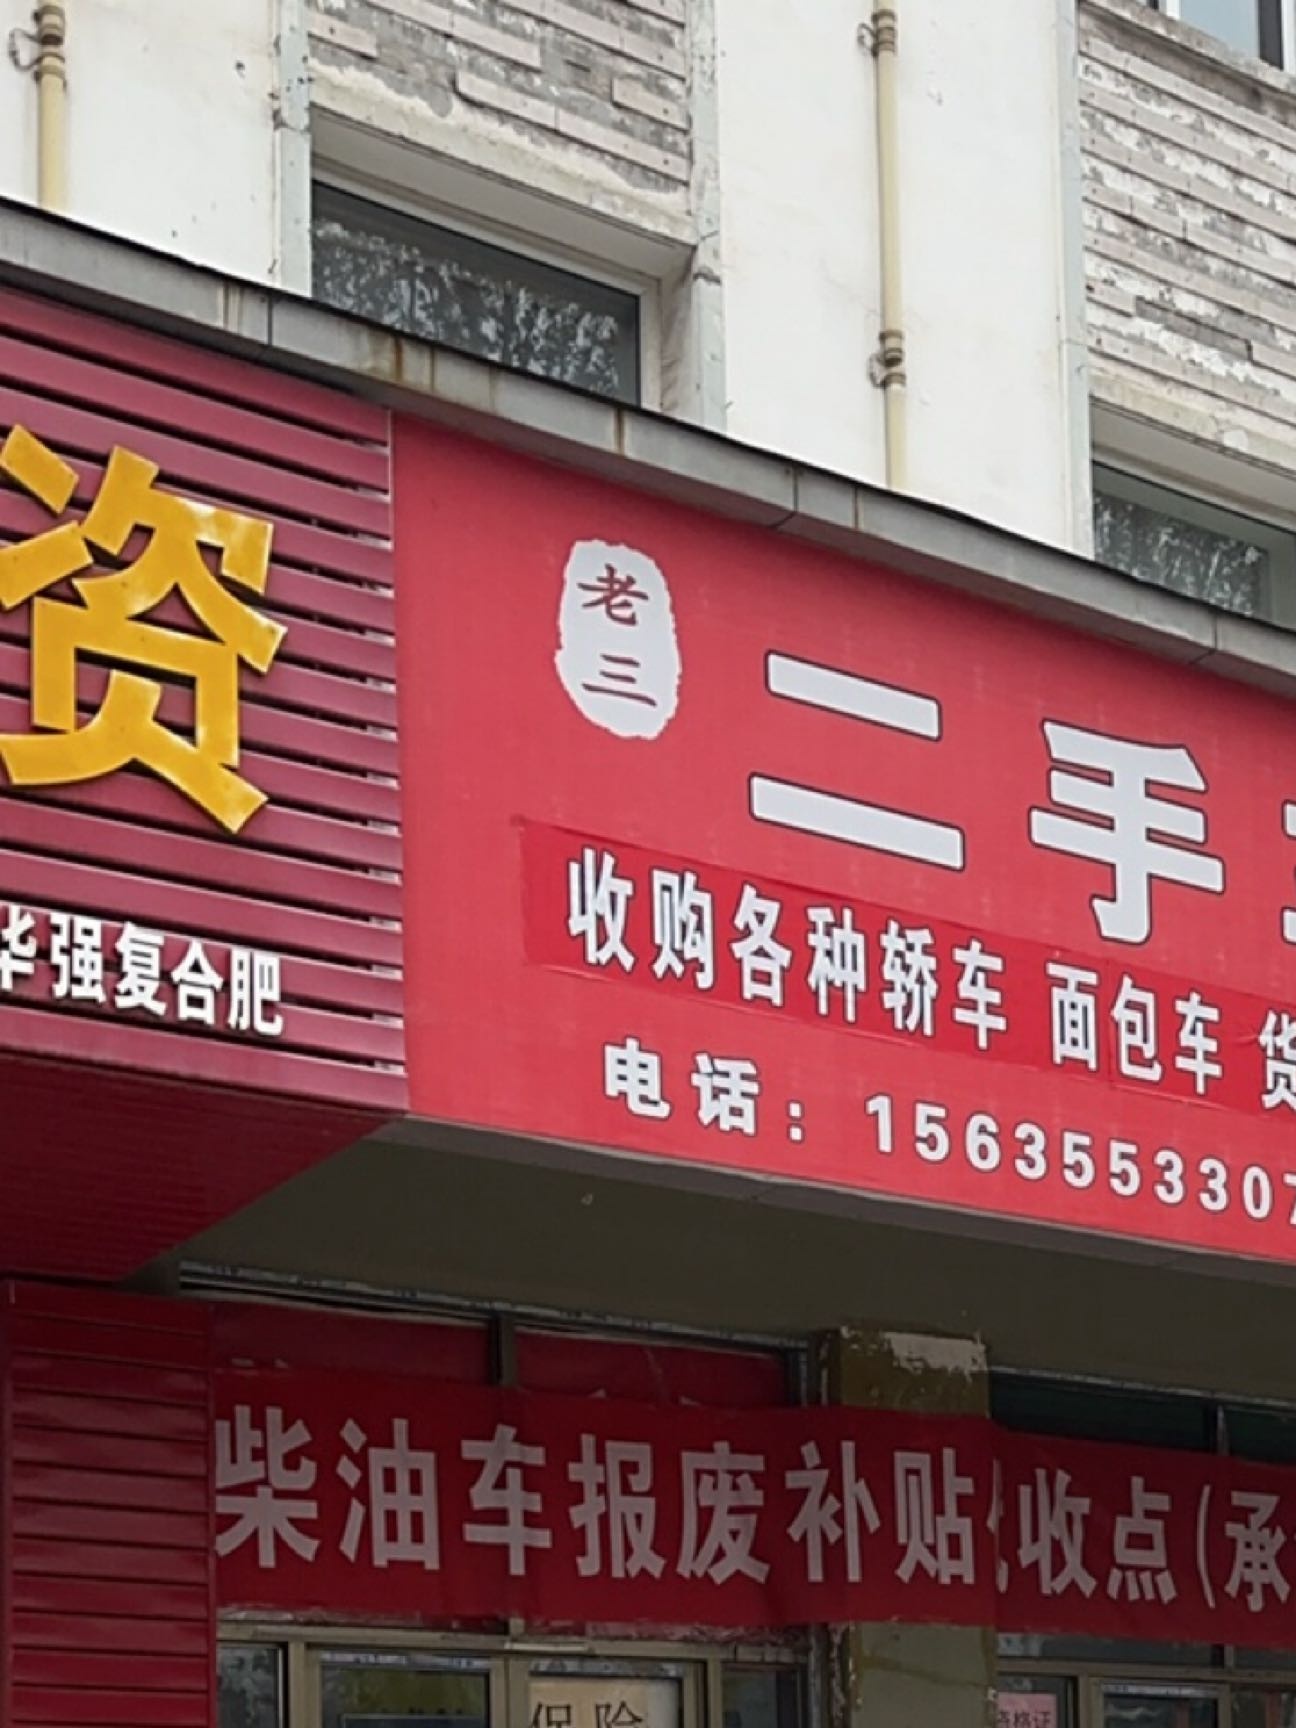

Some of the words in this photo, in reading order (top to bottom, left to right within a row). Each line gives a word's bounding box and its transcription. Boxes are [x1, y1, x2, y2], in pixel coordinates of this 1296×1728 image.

[0, 424, 288, 834] 资
[578, 563, 657, 706] 老三
[567, 847, 1007, 1050] 收购各种轿车
[1046, 961, 1224, 1095] 面包车
